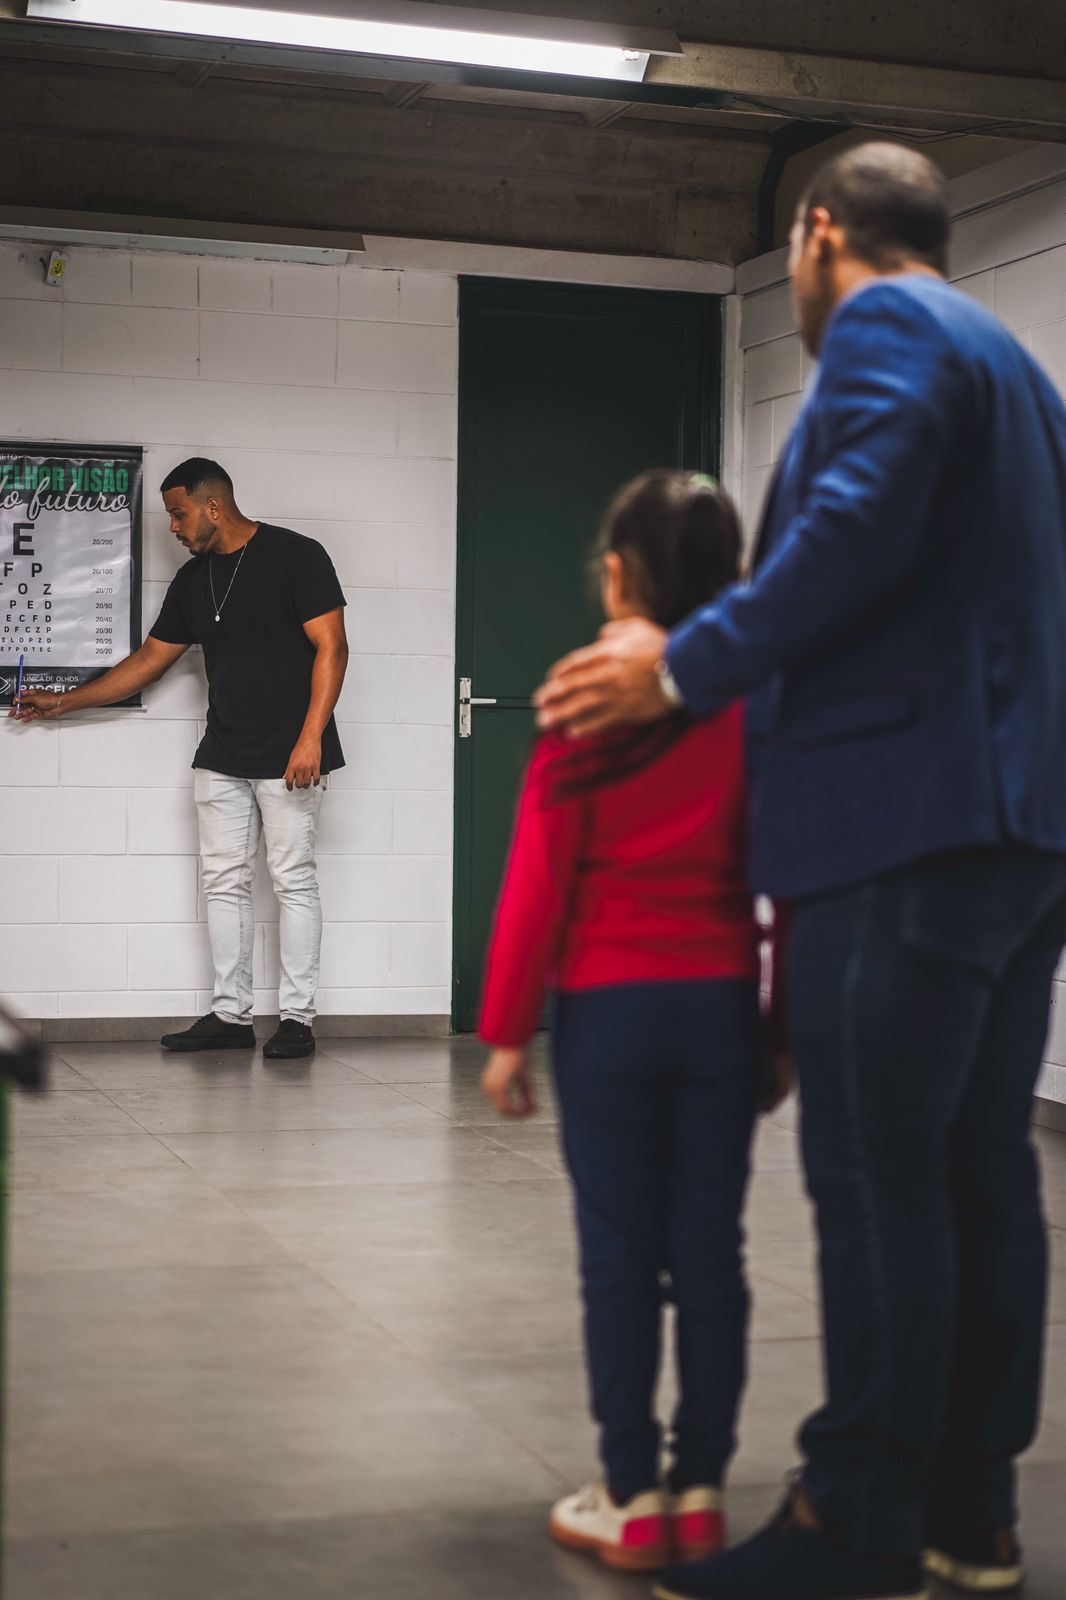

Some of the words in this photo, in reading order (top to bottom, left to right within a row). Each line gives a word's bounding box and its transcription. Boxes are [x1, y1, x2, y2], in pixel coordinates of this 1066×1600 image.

[0, 464, 65, 491] ELHOR
[71, 462, 129, 493] VISÃO
[28, 476, 130, 519] futuro
[13, 522, 35, 556] E
[4, 562, 14, 577] F
[31, 562, 43, 577] P
[18, 582, 28, 595] O
[43, 583, 52, 595] Z
